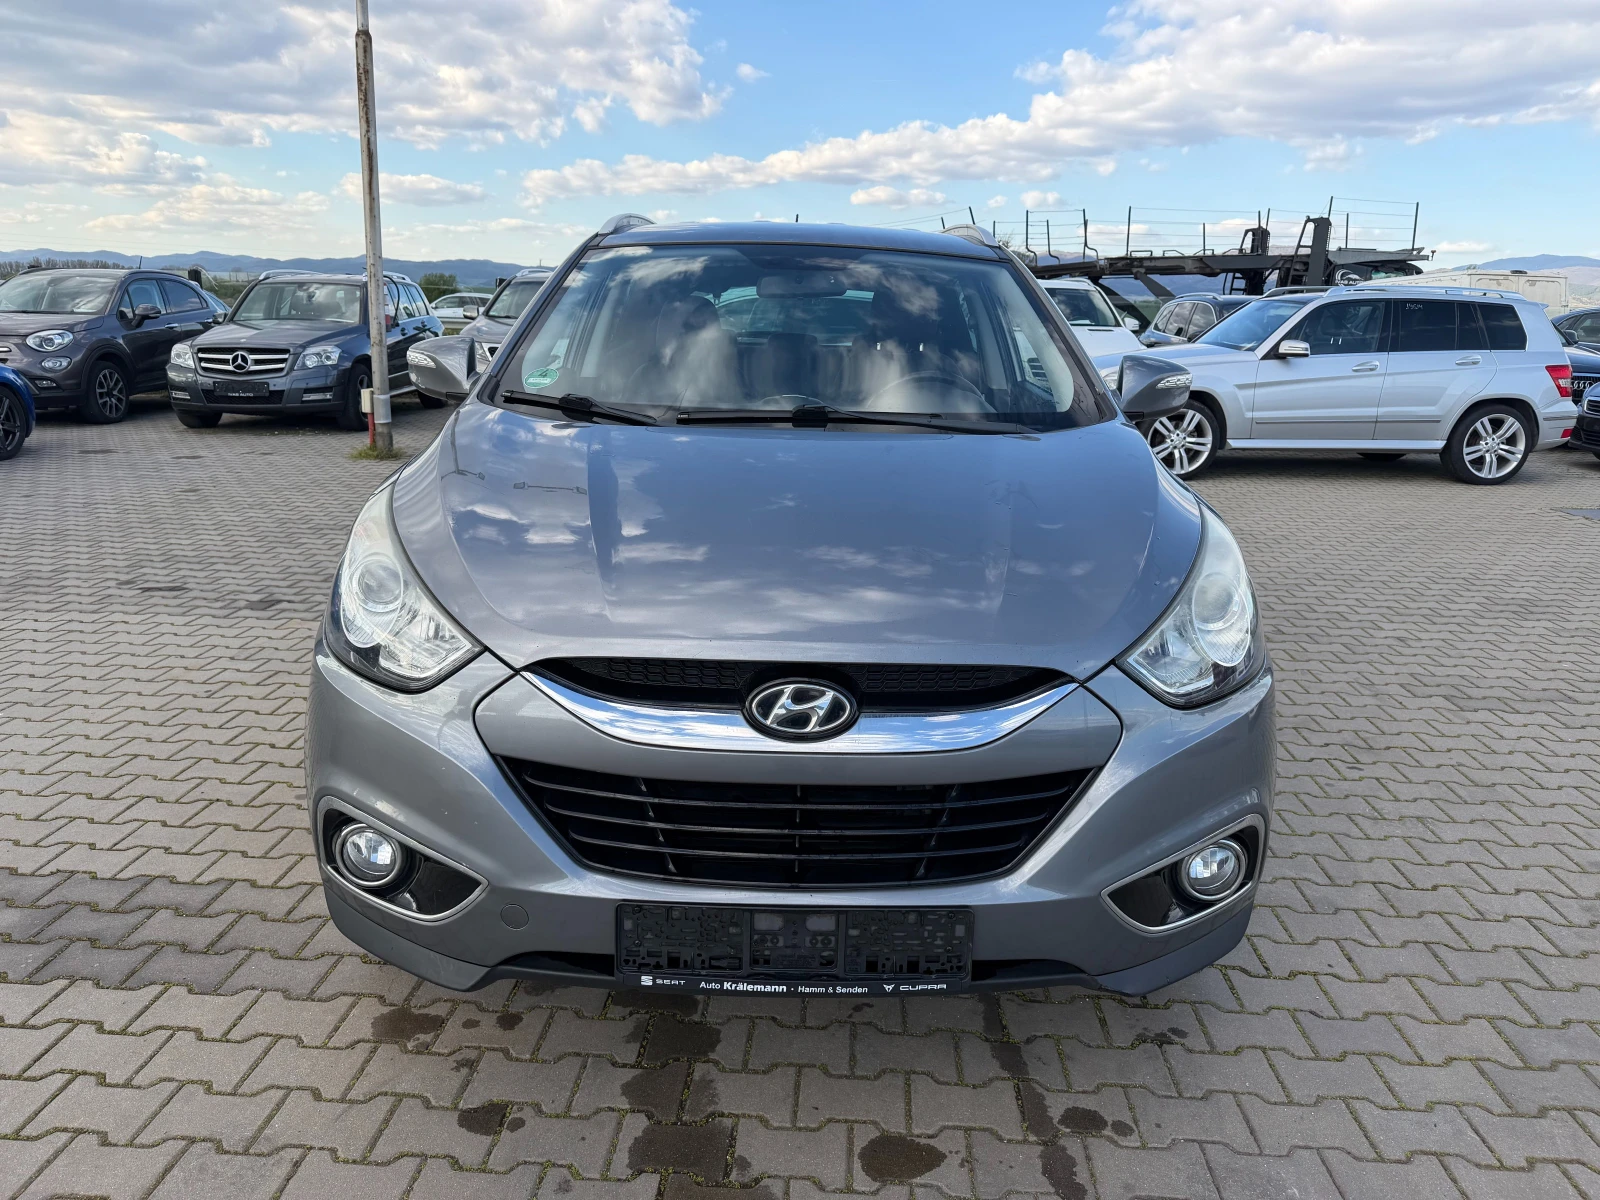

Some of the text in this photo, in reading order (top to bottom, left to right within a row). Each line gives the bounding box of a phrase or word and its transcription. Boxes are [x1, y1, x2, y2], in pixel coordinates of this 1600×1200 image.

[538, 369, 549, 378] 4
[655, 978, 686, 986] SEAT
[700, 981, 868, 993] Auto Krälemann Hamm & Senden
